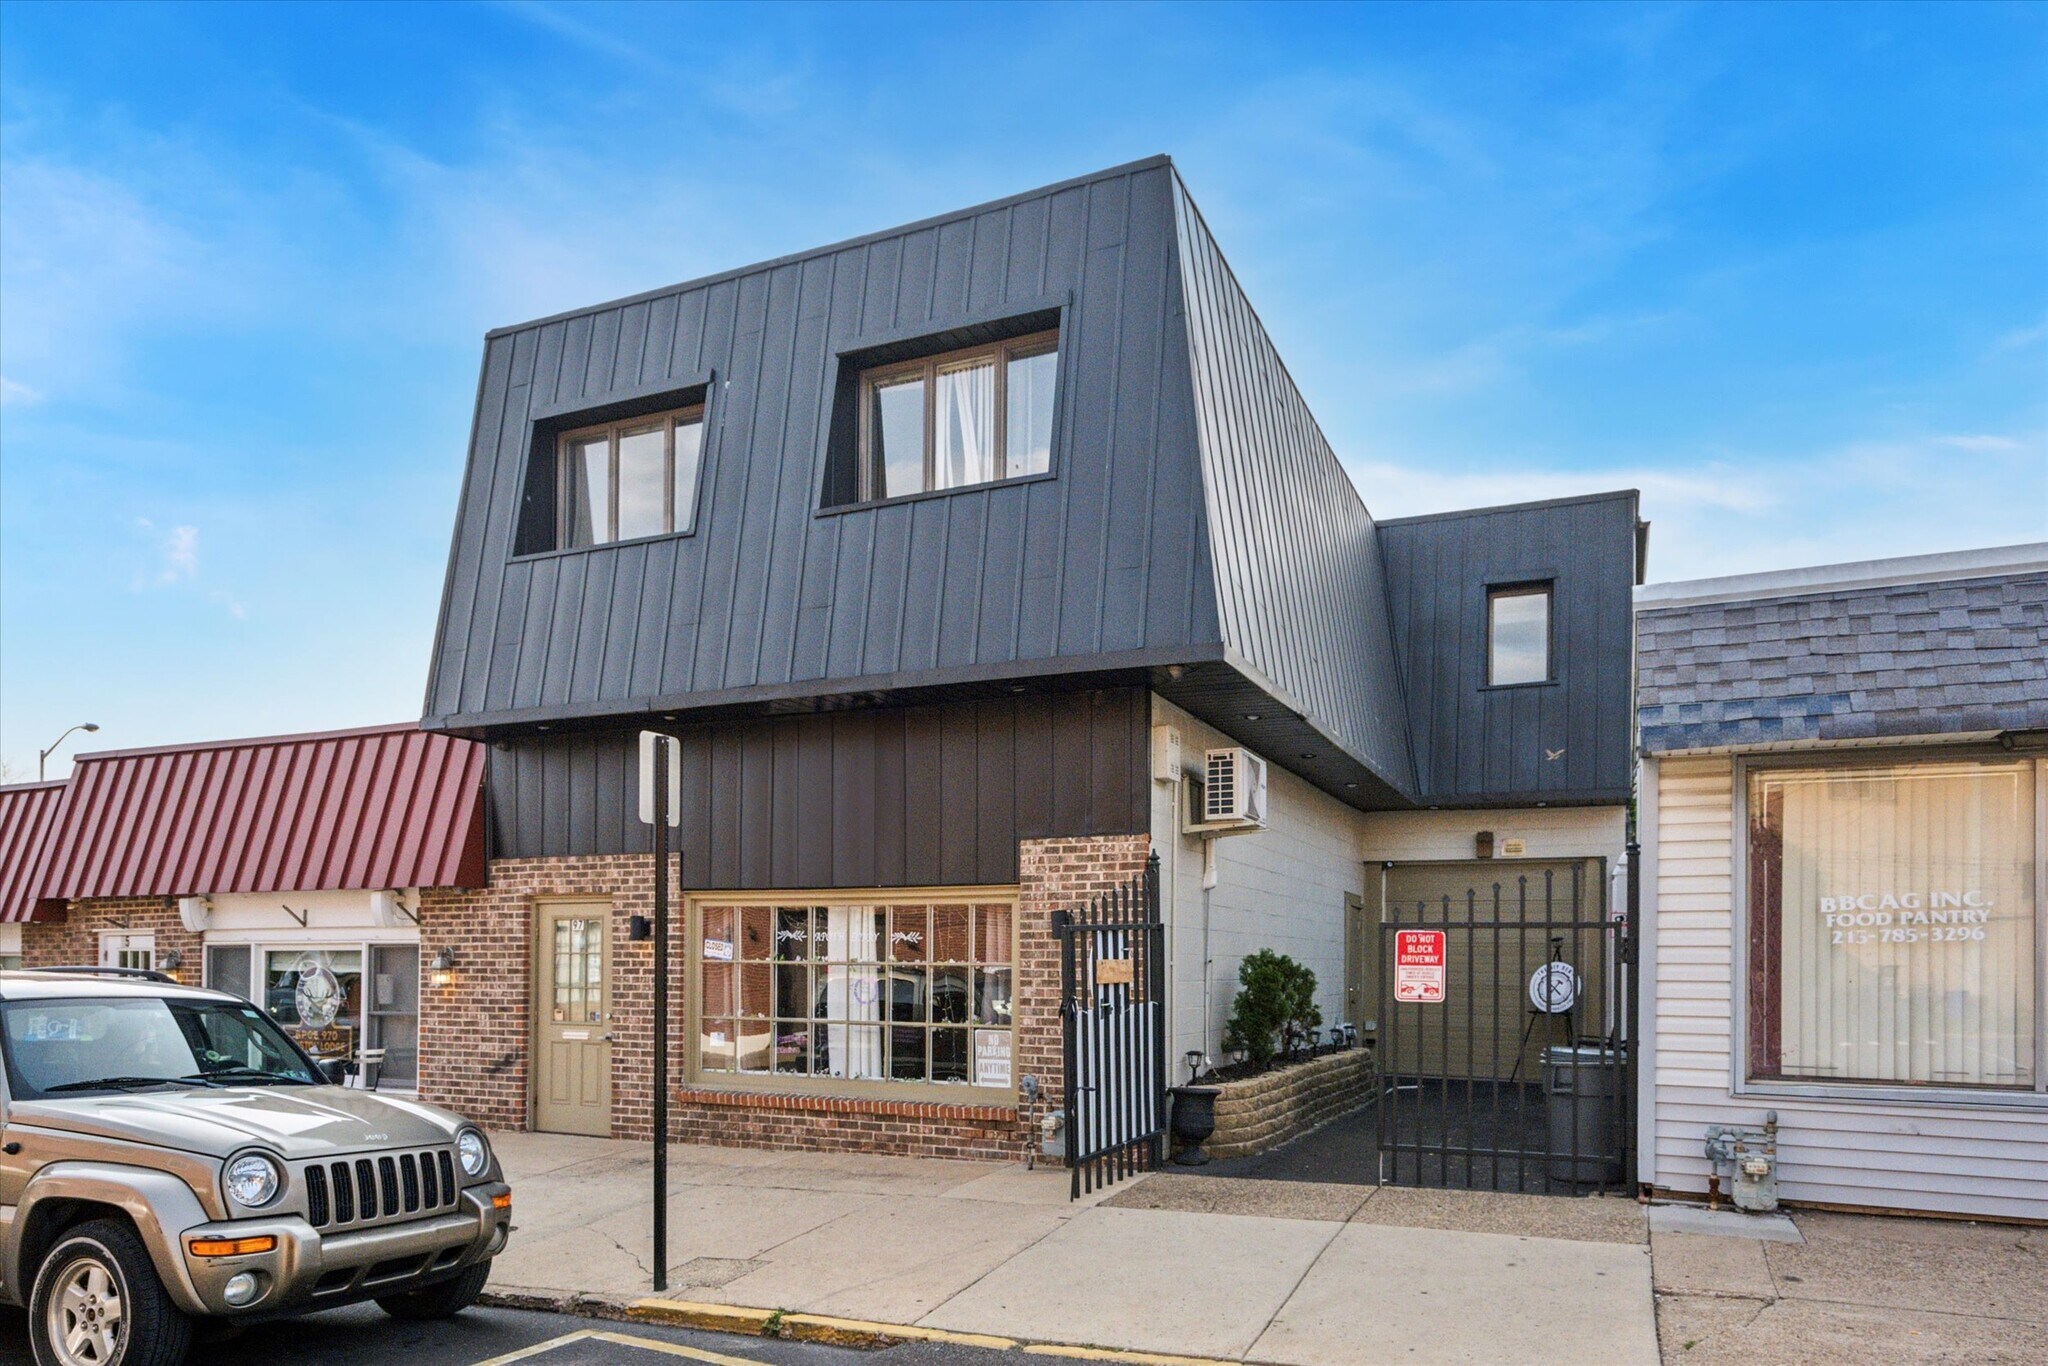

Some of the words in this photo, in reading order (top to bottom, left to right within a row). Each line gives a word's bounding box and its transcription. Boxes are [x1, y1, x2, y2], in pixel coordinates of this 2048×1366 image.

[1820, 893, 1921, 913] BBCAG
[1930, 890, 1994, 908] INC.
[1826, 911, 1893, 928] FOOD
[1900, 909, 1991, 926] PANTRY
[1406, 934, 1418, 944] DO
[1419, 934, 1436, 944] NOT
[706, 941, 724, 951] CLOSED
[1407, 944, 1434, 954] BLOCK
[1401, 954, 1440, 964] DRIVEWAY
[321, 1031, 338, 1041] 970
[989, 1034, 999, 1045] NO
[980, 1063, 1010, 1074] ANYTIME
